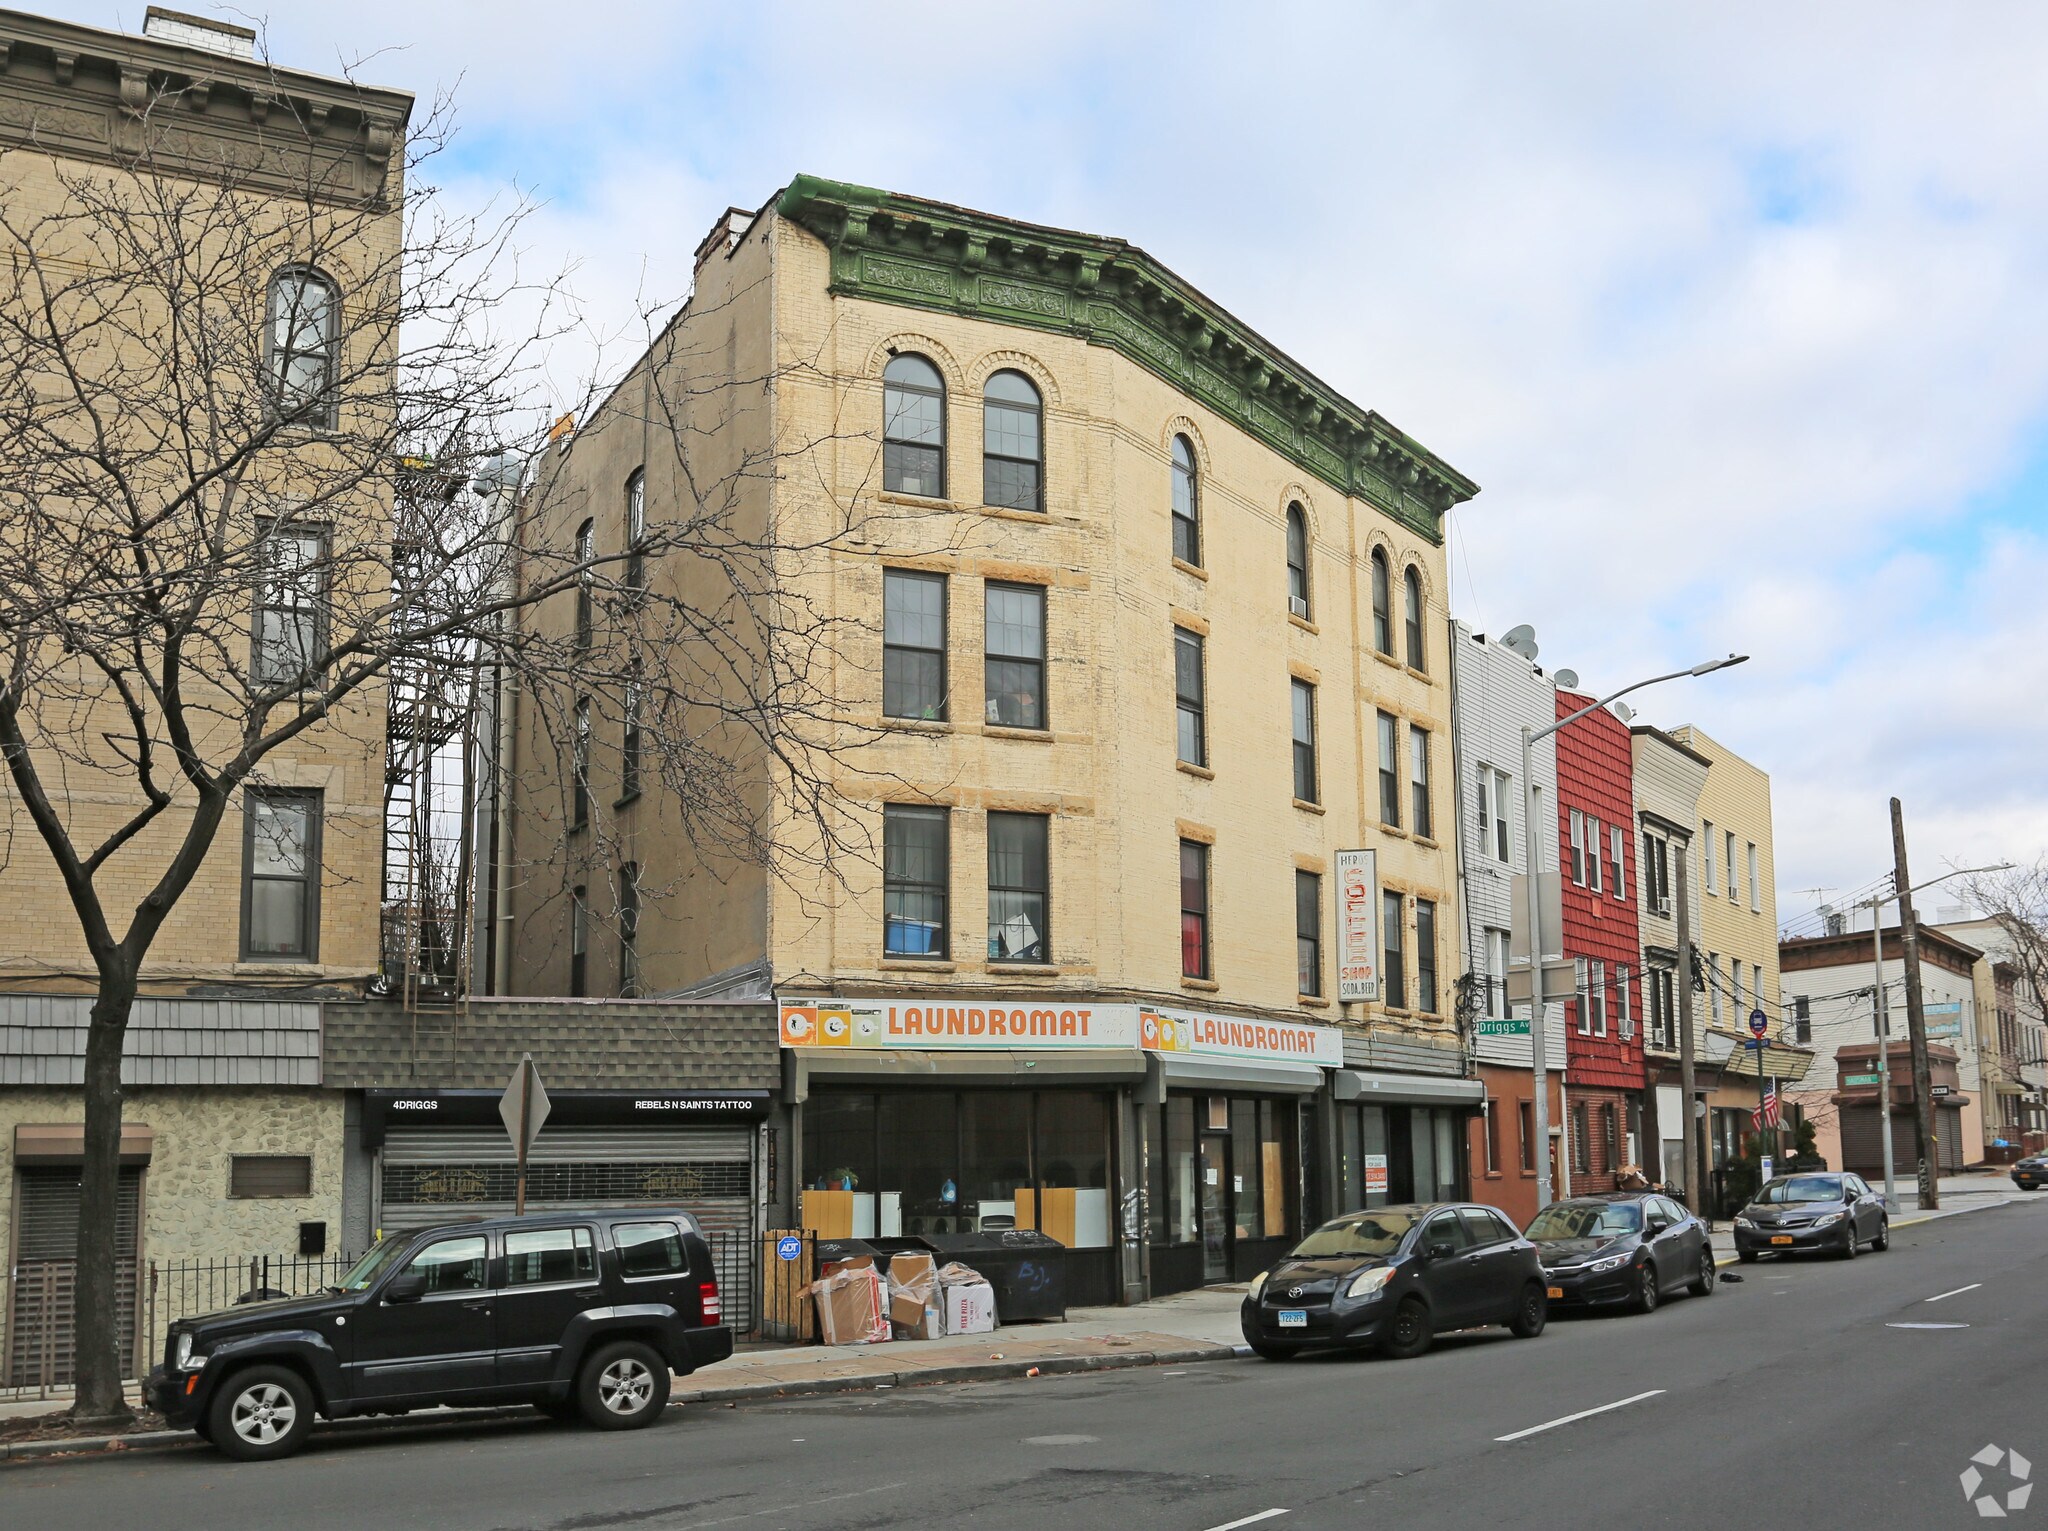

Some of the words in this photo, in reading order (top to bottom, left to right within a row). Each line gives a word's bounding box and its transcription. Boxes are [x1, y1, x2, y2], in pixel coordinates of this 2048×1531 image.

[1342, 966, 1372, 980] SHOP
[888, 1007, 1091, 1036] LAUNDROMAT
[1479, 1021, 1516, 1034] Driggs
[1193, 1018, 1315, 1053] LAUNDROMAT
[393, 1101, 438, 1110] 4DRIGGS
[635, 1101, 671, 1109] REBELS
[672, 1101, 679, 1109] N
[680, 1101, 713, 1109] SAINTS
[715, 1101, 752, 1109] TATTOO
[780, 1243, 798, 1253] ADT
[960, 1299, 968, 1315] PIZZA
